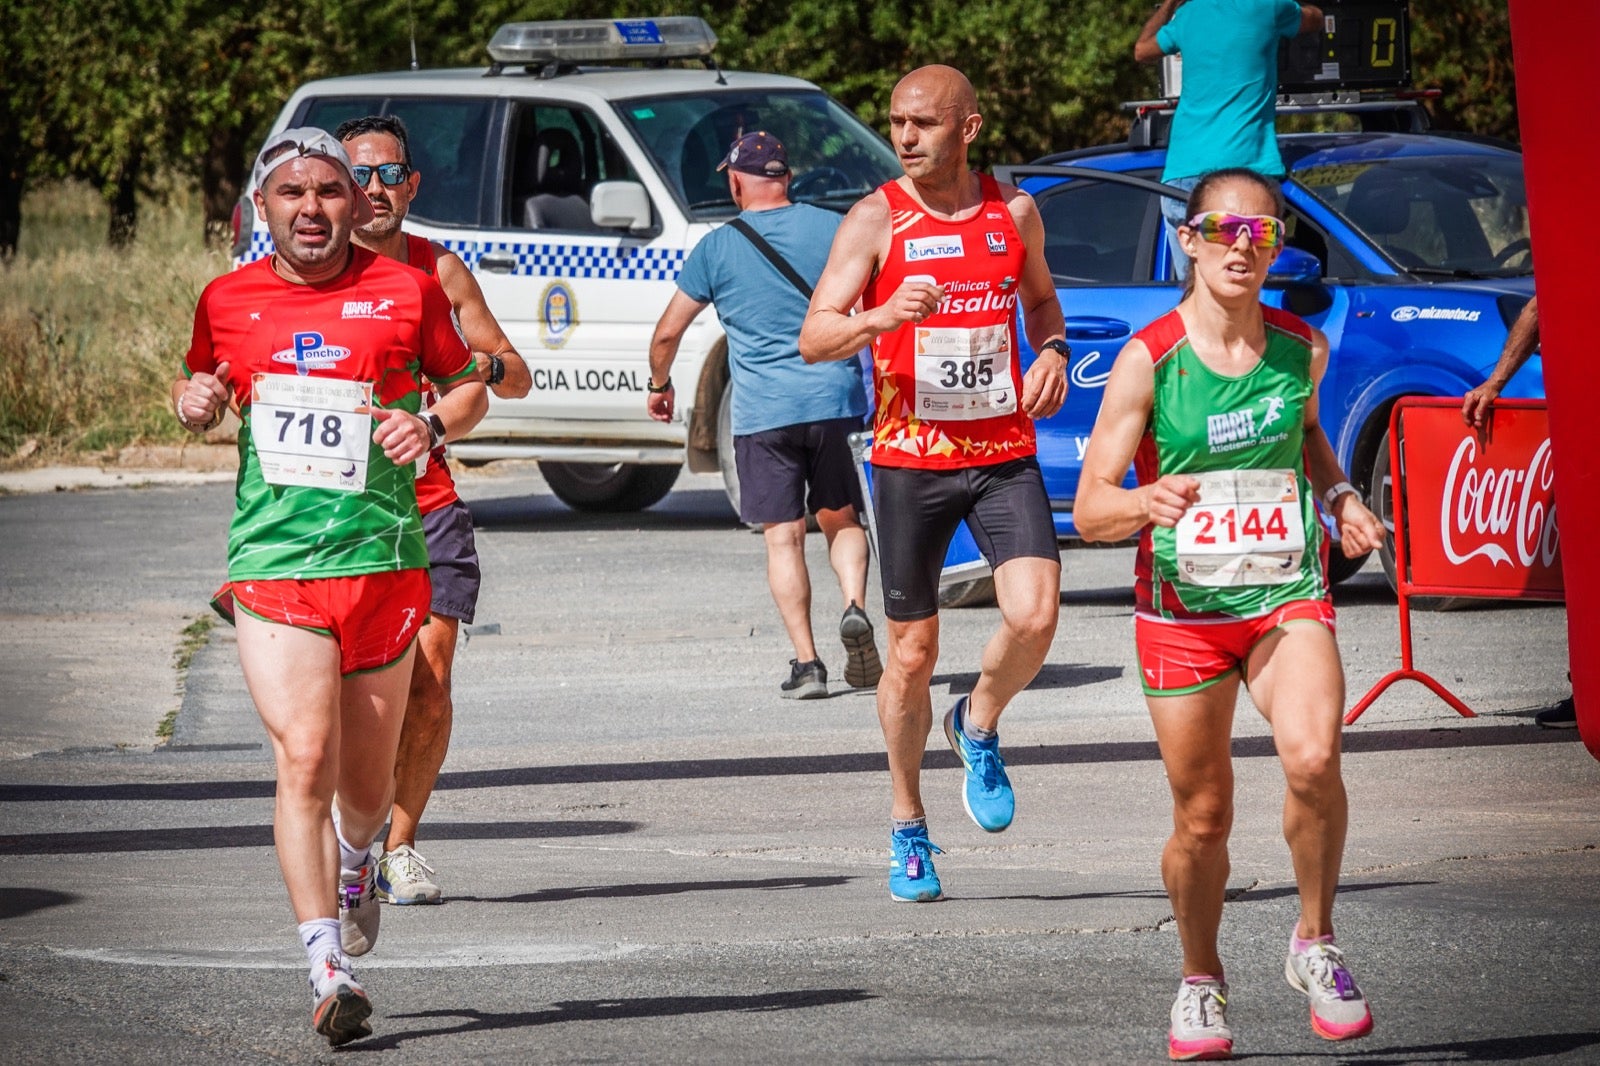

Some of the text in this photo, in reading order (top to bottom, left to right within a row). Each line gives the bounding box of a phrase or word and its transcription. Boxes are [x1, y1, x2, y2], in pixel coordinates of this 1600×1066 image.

[943, 280, 991, 293] Clínicas
[294, 332, 341, 361] Poncho
[575, 369, 643, 392] LOCAL
[940, 358, 994, 389] 385
[274, 410, 342, 448] 718
[1209, 432, 1289, 455] Atletismo Atarfe
[1193, 507, 1288, 545] 2144
